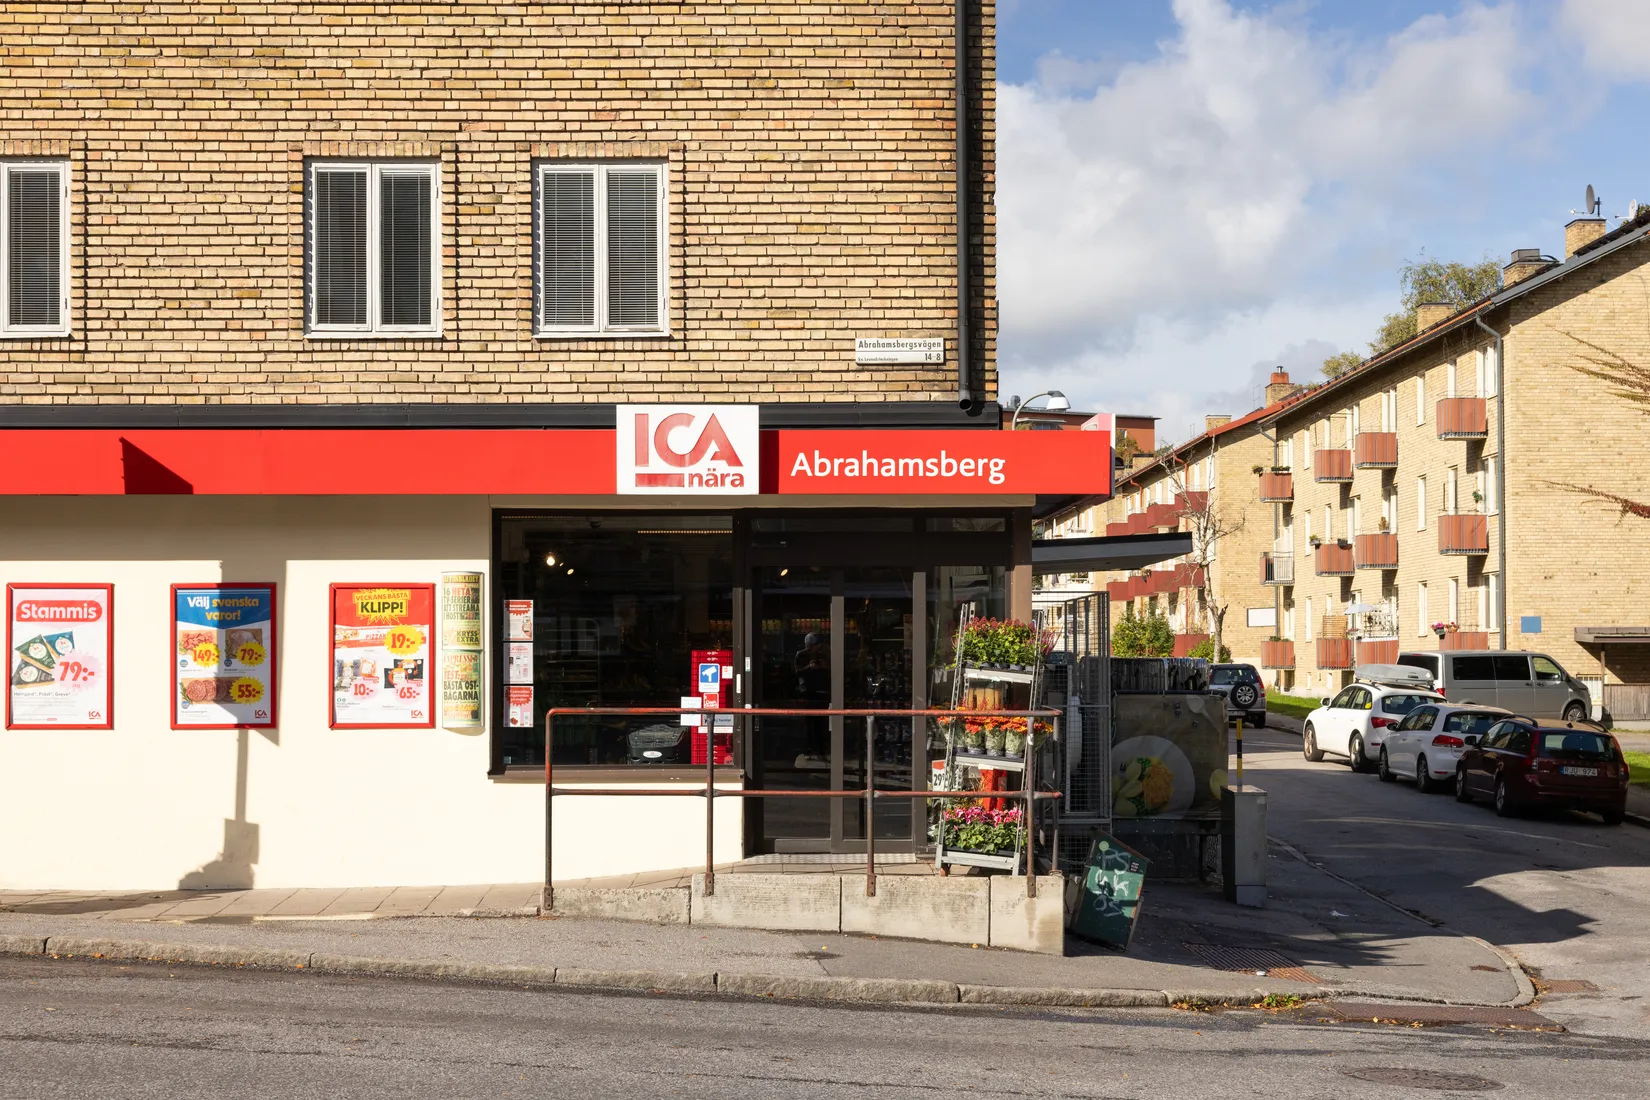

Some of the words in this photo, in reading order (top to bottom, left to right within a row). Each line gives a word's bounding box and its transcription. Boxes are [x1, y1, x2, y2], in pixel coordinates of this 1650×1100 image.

[858, 340, 941, 350] Abrahamsbergsvägen
[634, 412, 744, 468] ICA
[790, 450, 1005, 485] Abrahamsberg
[688, 468, 744, 488] nära
[452, 588, 471, 596] HETA
[187, 596, 210, 610] Välj
[212, 596, 259, 607] svenska
[360, 601, 404, 613] KLIPP!
[452, 603, 480, 611] STREAMA
[20, 603, 97, 619] Stammis
[205, 610, 241, 620] varor!
[391, 633, 416, 649] 19:-
[193, 649, 219, 662] 149:-
[240, 648, 262, 661] 79:-
[59, 661, 95, 682] 79:-
[237, 684, 261, 698] 55:-
[353, 683, 374, 696] 10:-
[399, 687, 420, 699] 65:-
[254, 709, 267, 717] ICA
[410, 709, 423, 717] ICA
[1564, 766, 1578, 775] RJU
[1582, 768, 1596, 776] 974
